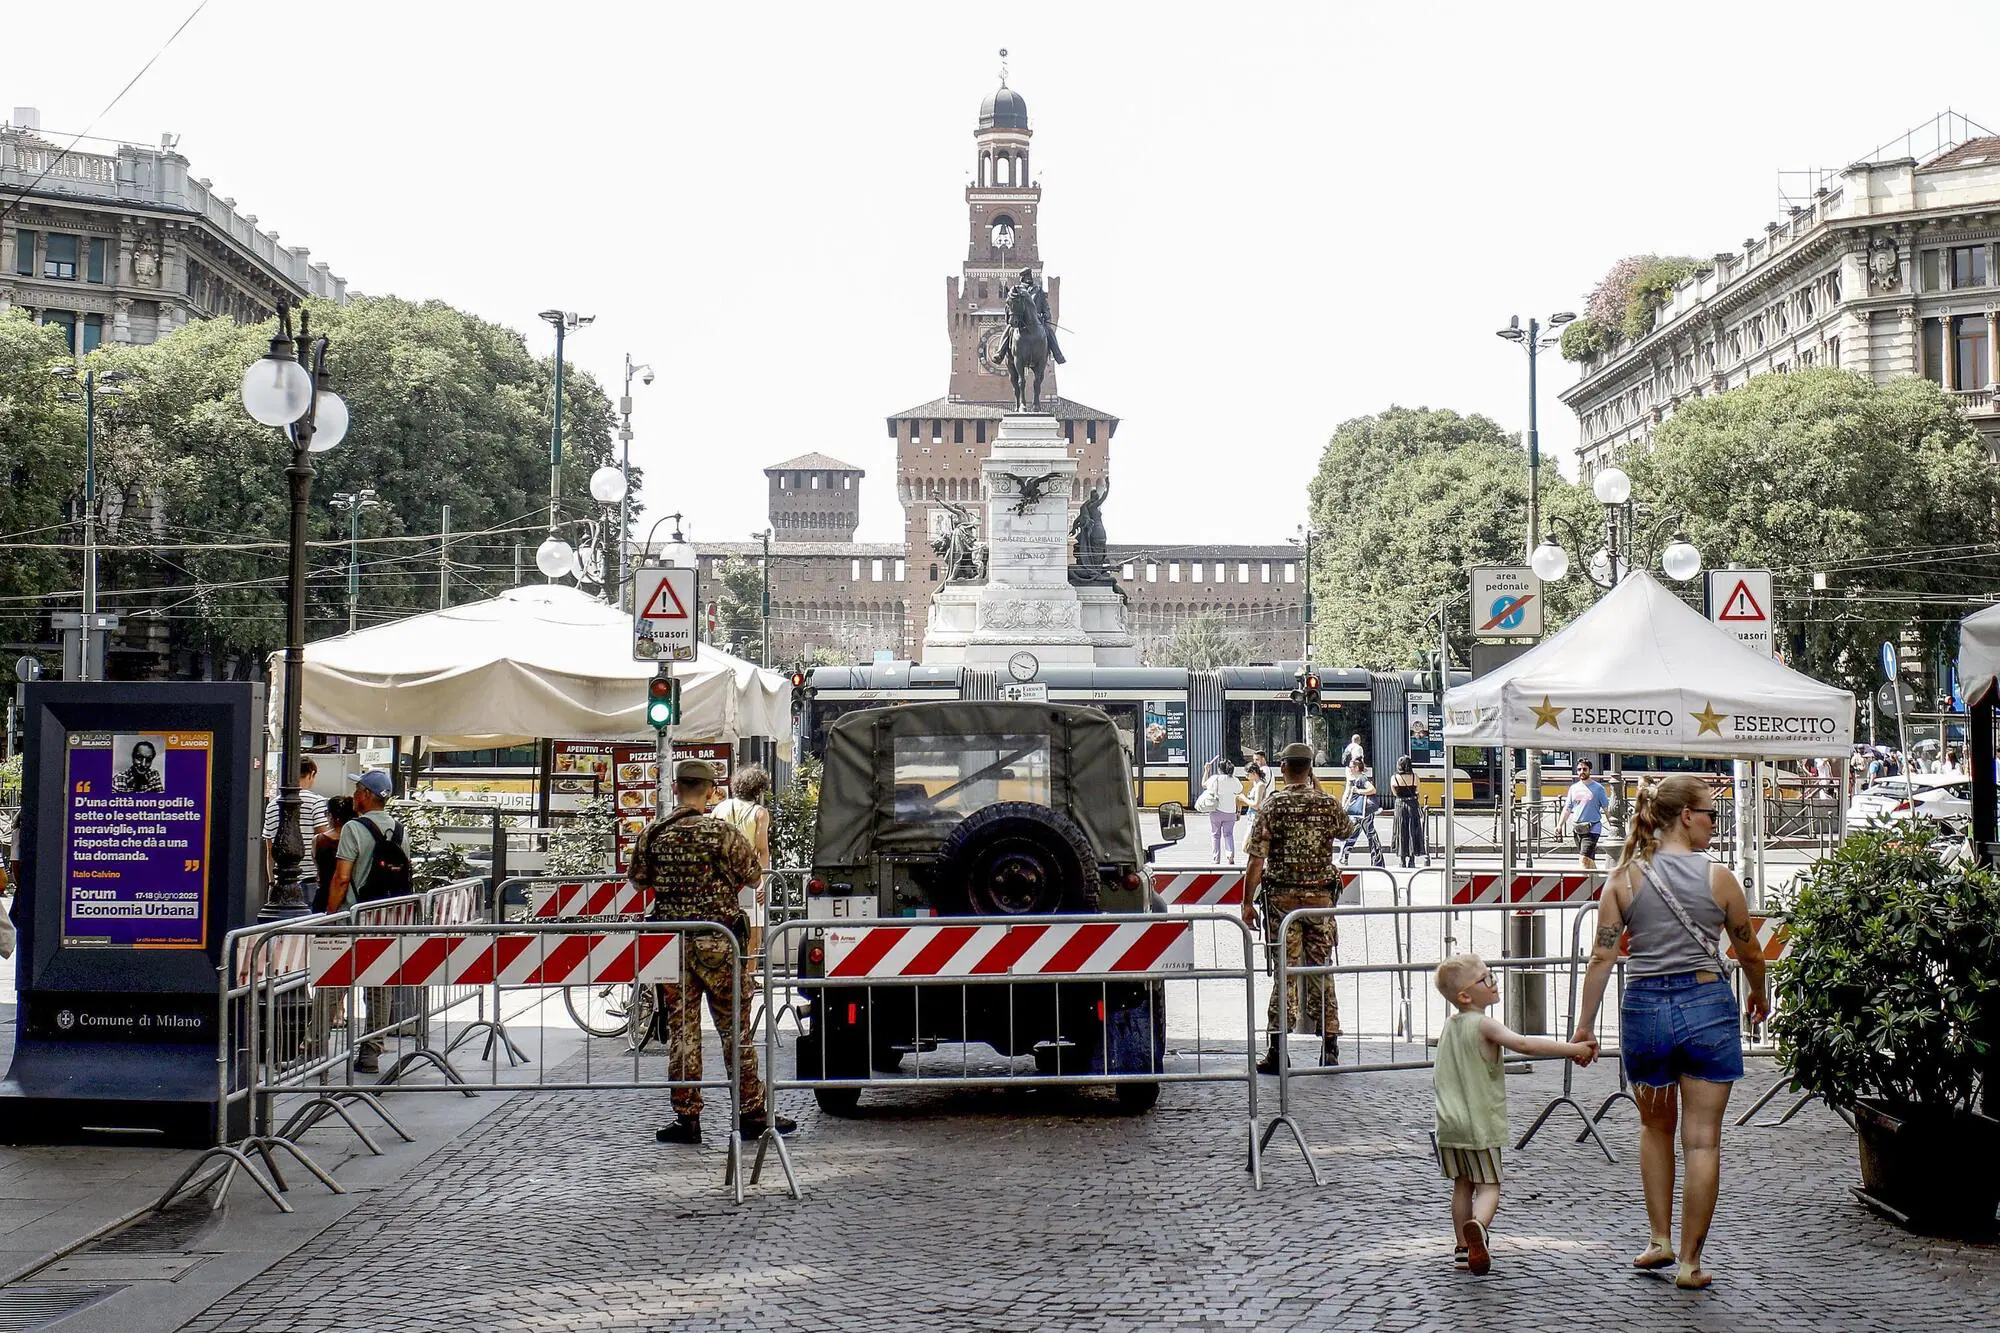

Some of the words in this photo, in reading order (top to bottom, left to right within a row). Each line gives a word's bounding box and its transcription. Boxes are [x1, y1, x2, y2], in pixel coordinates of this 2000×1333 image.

[1486, 583, 1530, 592] pedonale
[1572, 708, 1674, 726] ESERCITO
[1734, 716, 1836, 734] ESERCITO
[566, 745, 599, 754] APERITIVI
[672, 750, 694, 760] GRILL
[698, 750, 715, 758] BAR
[108, 797, 134, 807] città
[136, 799, 157, 807] non
[158, 797, 182, 809] godi
[183, 797, 194, 807] le
[74, 811, 104, 820] sette
[114, 810, 124, 820] le
[125, 811, 200, 820] settantasette
[74, 824, 136, 836] meraviglie,
[156, 824, 166, 834] la
[74, 838, 120, 849] risposta
[120, 838, 142, 848] che
[143, 838, 158, 848] dà
[158, 840, 166, 848] a
[167, 840, 188, 848] una
[74, 852, 92, 860] tua
[94, 850, 149, 860] domanda.
[91, 870, 121, 878] Calvino
[72, 887, 116, 900] Forum
[154, 890, 178, 901] giugno
[76, 904, 142, 916] Economia
[144, 904, 195, 916] Urbana
[832, 898, 850, 918] EI
[80, 1013, 134, 1026] Comune
[139, 1014, 151, 1026] di
[156, 1014, 201, 1028] Milano
